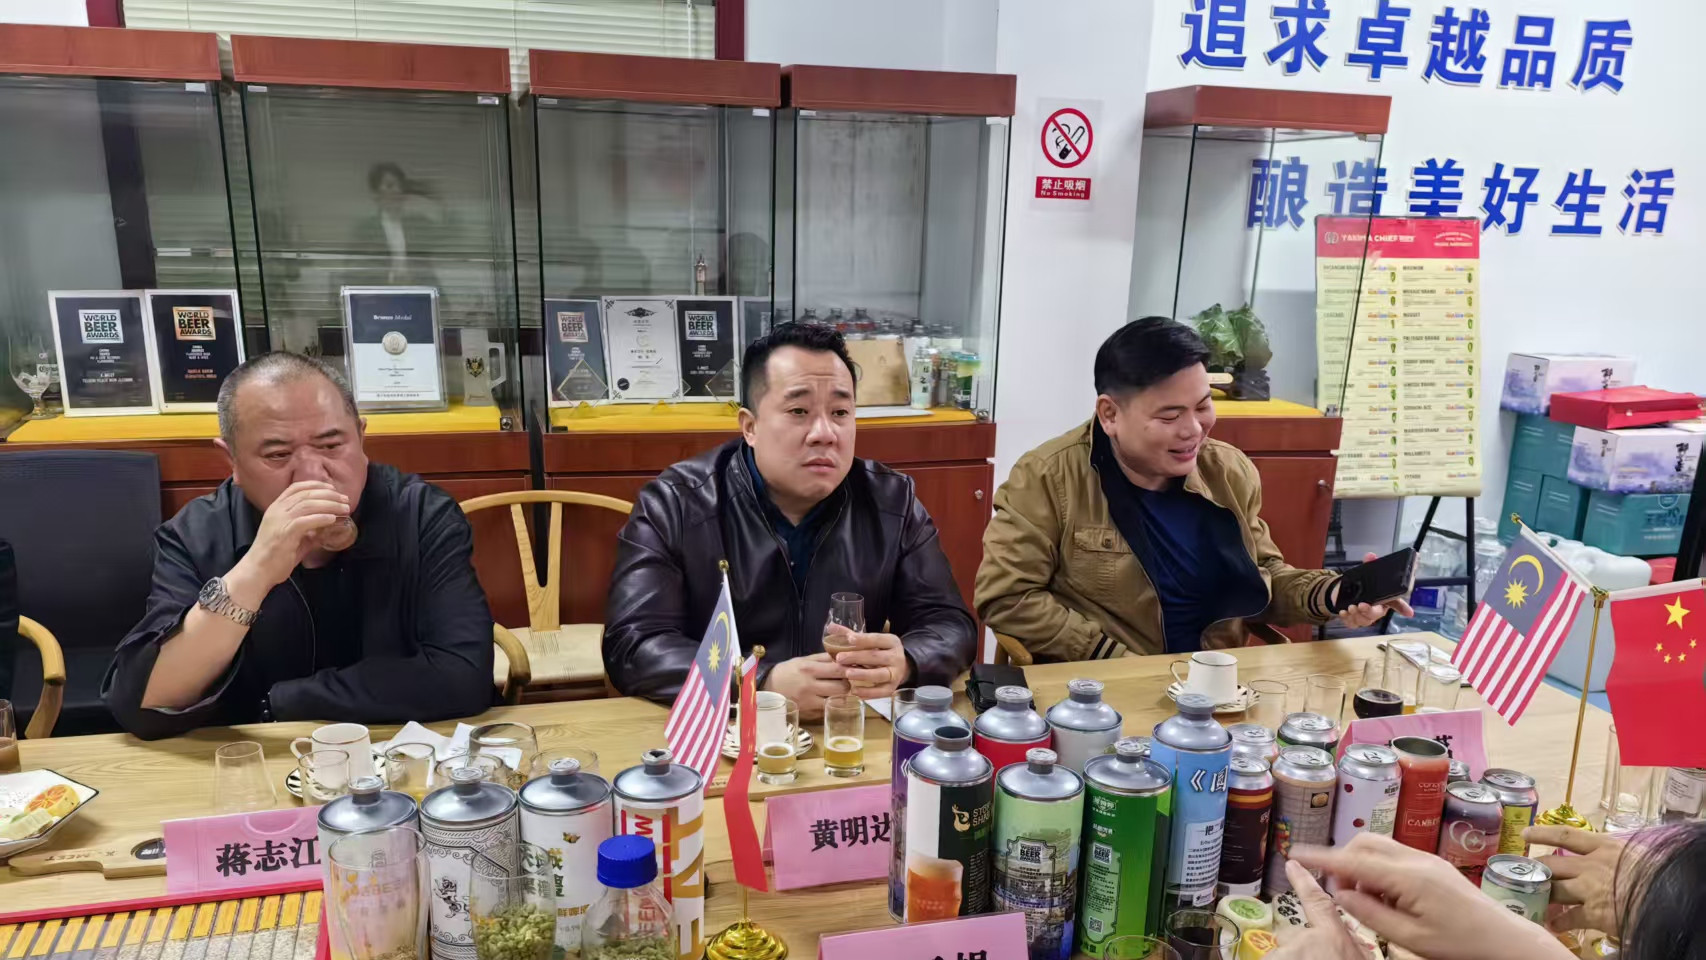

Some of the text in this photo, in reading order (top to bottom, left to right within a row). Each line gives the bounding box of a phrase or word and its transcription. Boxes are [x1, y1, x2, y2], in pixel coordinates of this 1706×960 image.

[1180, 0, 1634, 93] 追求卓越品质
[1041, 178, 1087, 190] 禁止吸烟
[1246, 156, 1675, 236] 酿造美好生活
[84, 322, 117, 332] BEER
[178, 318, 210, 329] BEER
[561, 323, 583, 332] BEER
[688, 322, 714, 331] BEER
[808, 812, 890, 852] 黄明达
[215, 836, 321, 877] 蒋志江
[1019, 850, 1041, 858] BEER
